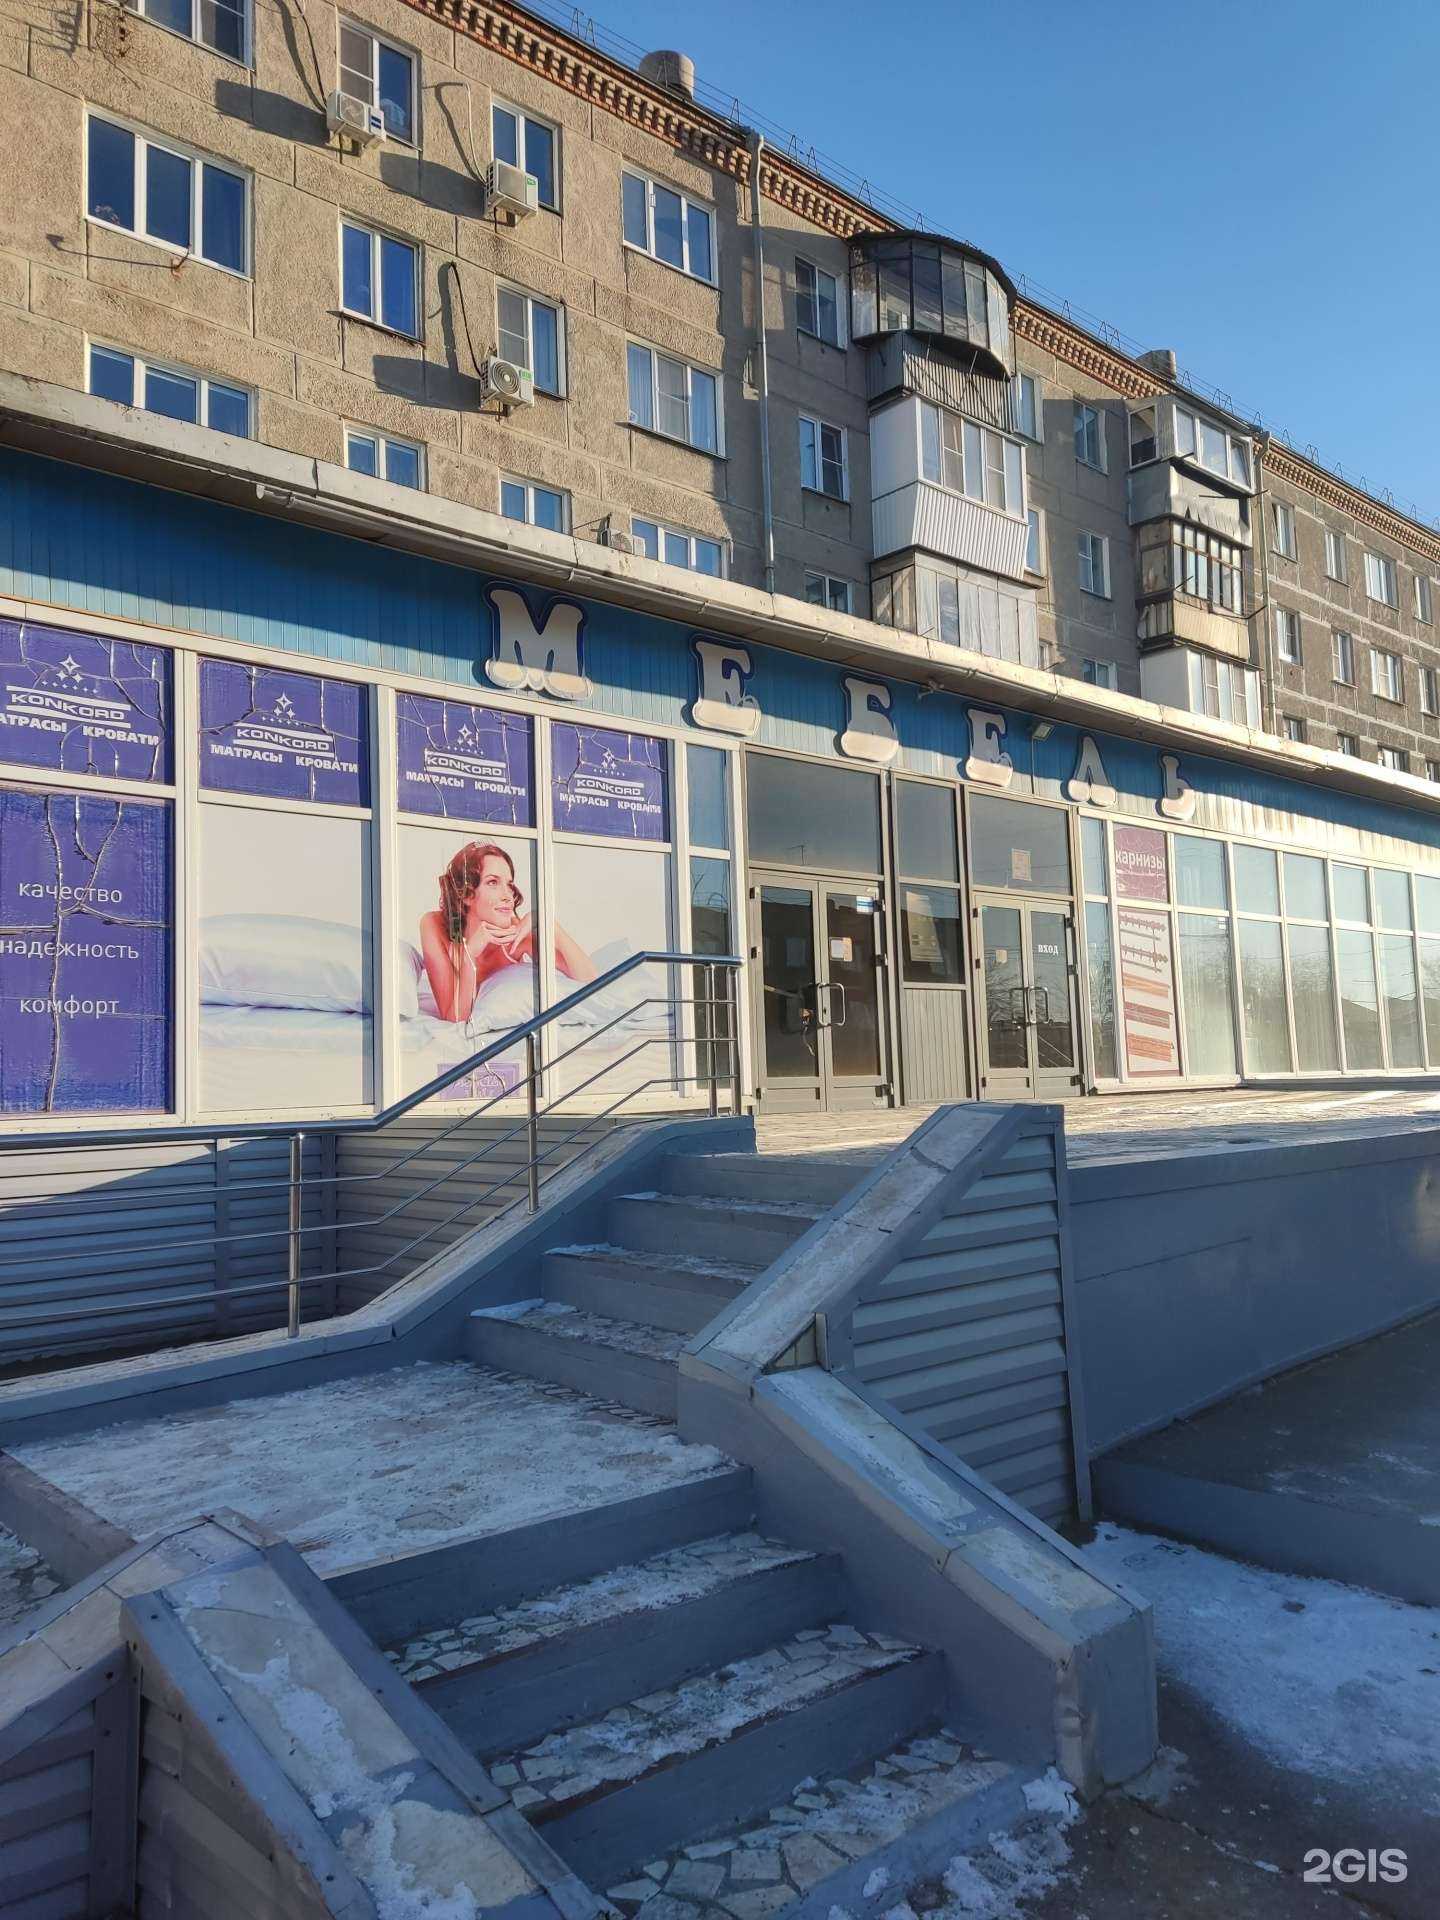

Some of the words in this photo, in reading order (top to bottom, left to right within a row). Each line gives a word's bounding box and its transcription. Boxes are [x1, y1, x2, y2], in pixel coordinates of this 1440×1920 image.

[11, 693, 125, 720] KONKORD
[484, 587, 1196, 821] МЕБЕЛЬ
[83, 725, 159, 746] КРОВАТИ
[236, 728, 330, 751] KONKORD
[210, 743, 283, 763] МАТРАСЫ
[295, 755, 358, 773] КРОВАТИ
[426, 756, 502, 776] KONKORD
[406, 771, 464, 788] МАТРАСЫ
[474, 781, 526, 796] КРОВАТИ
[577, 779, 641, 796] KONKORD
[559, 792, 609, 808] МАТРАСЫ
[618, 800, 661, 814] КРОВАТИ
[1115, 850, 1165, 870] карнизы
[19, 882, 122, 903] качество
[0, 940, 139, 959] надежность
[20, 995, 120, 1019] комфорт
